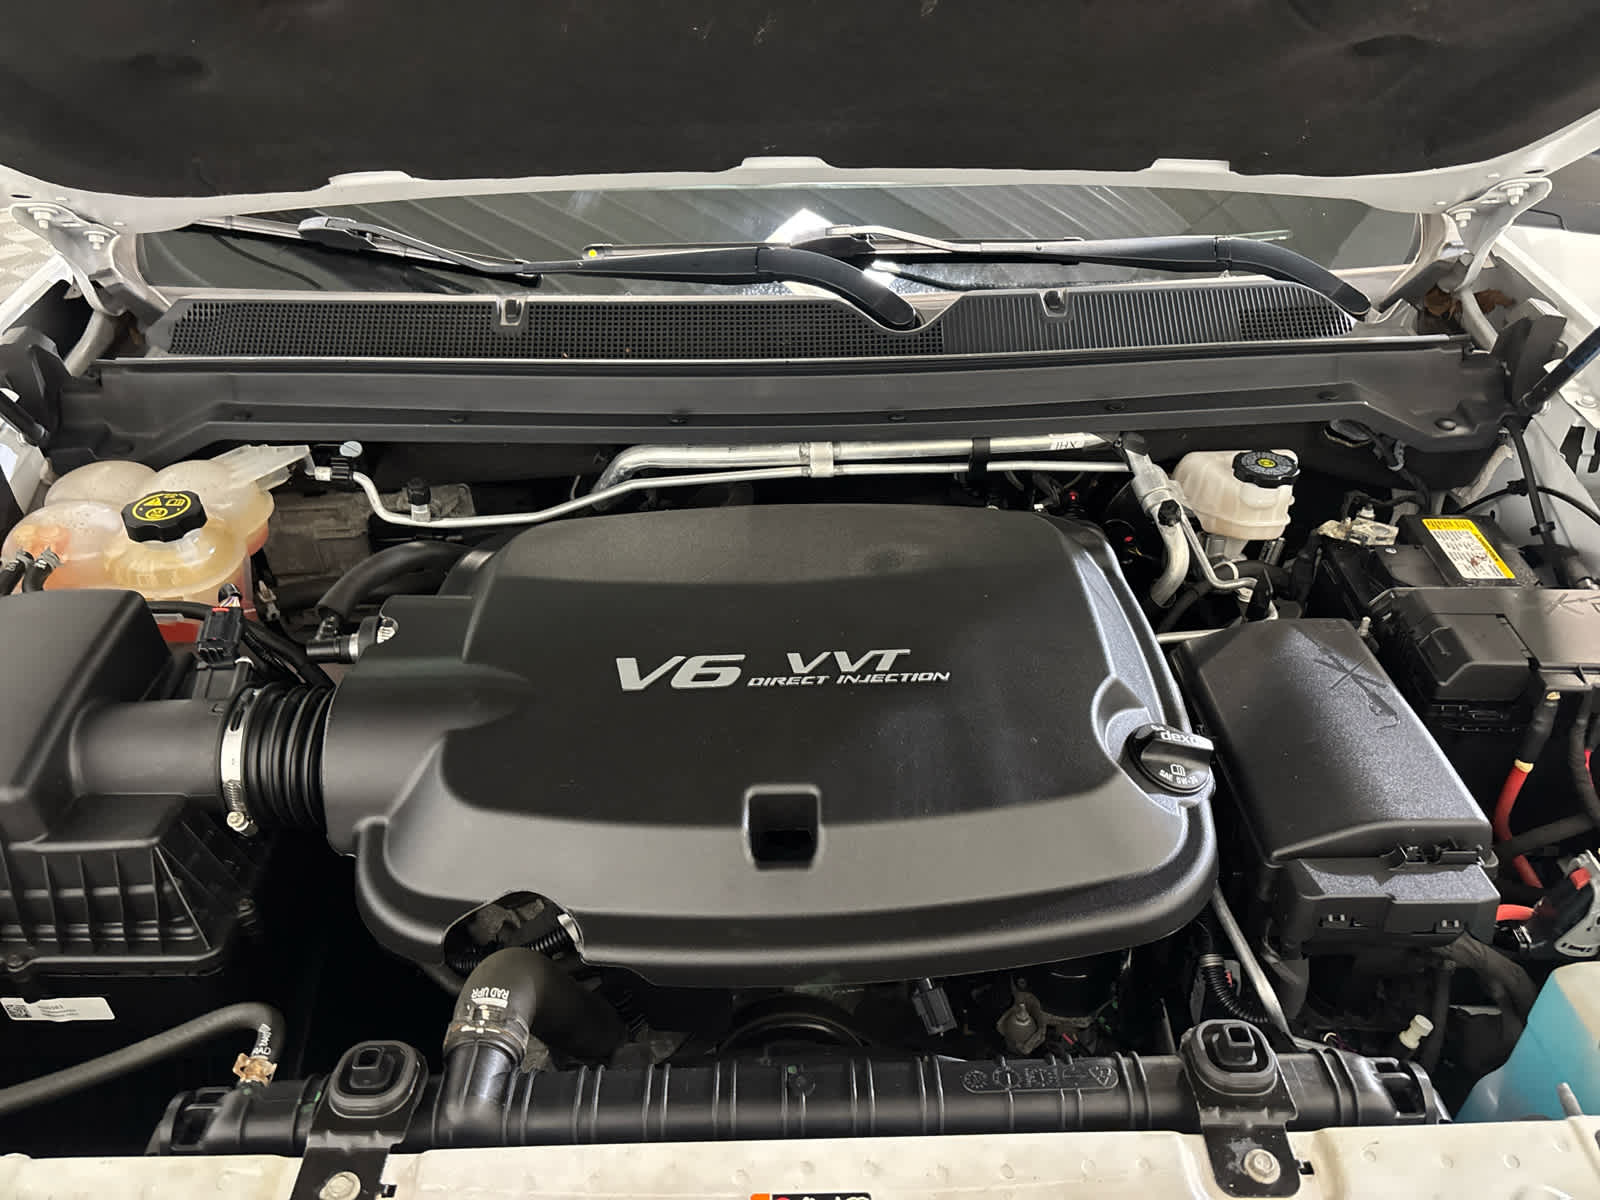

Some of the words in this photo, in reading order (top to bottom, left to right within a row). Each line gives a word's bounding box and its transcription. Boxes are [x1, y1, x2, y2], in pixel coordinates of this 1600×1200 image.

[787, 649, 911, 674] VVT
[616, 655, 746, 691] V6
[747, 675, 829, 687] DIRECT
[836, 671, 951, 684] INJECTION
[1160, 730, 1206, 746] dexo
[490, 987, 510, 1000] RAD
